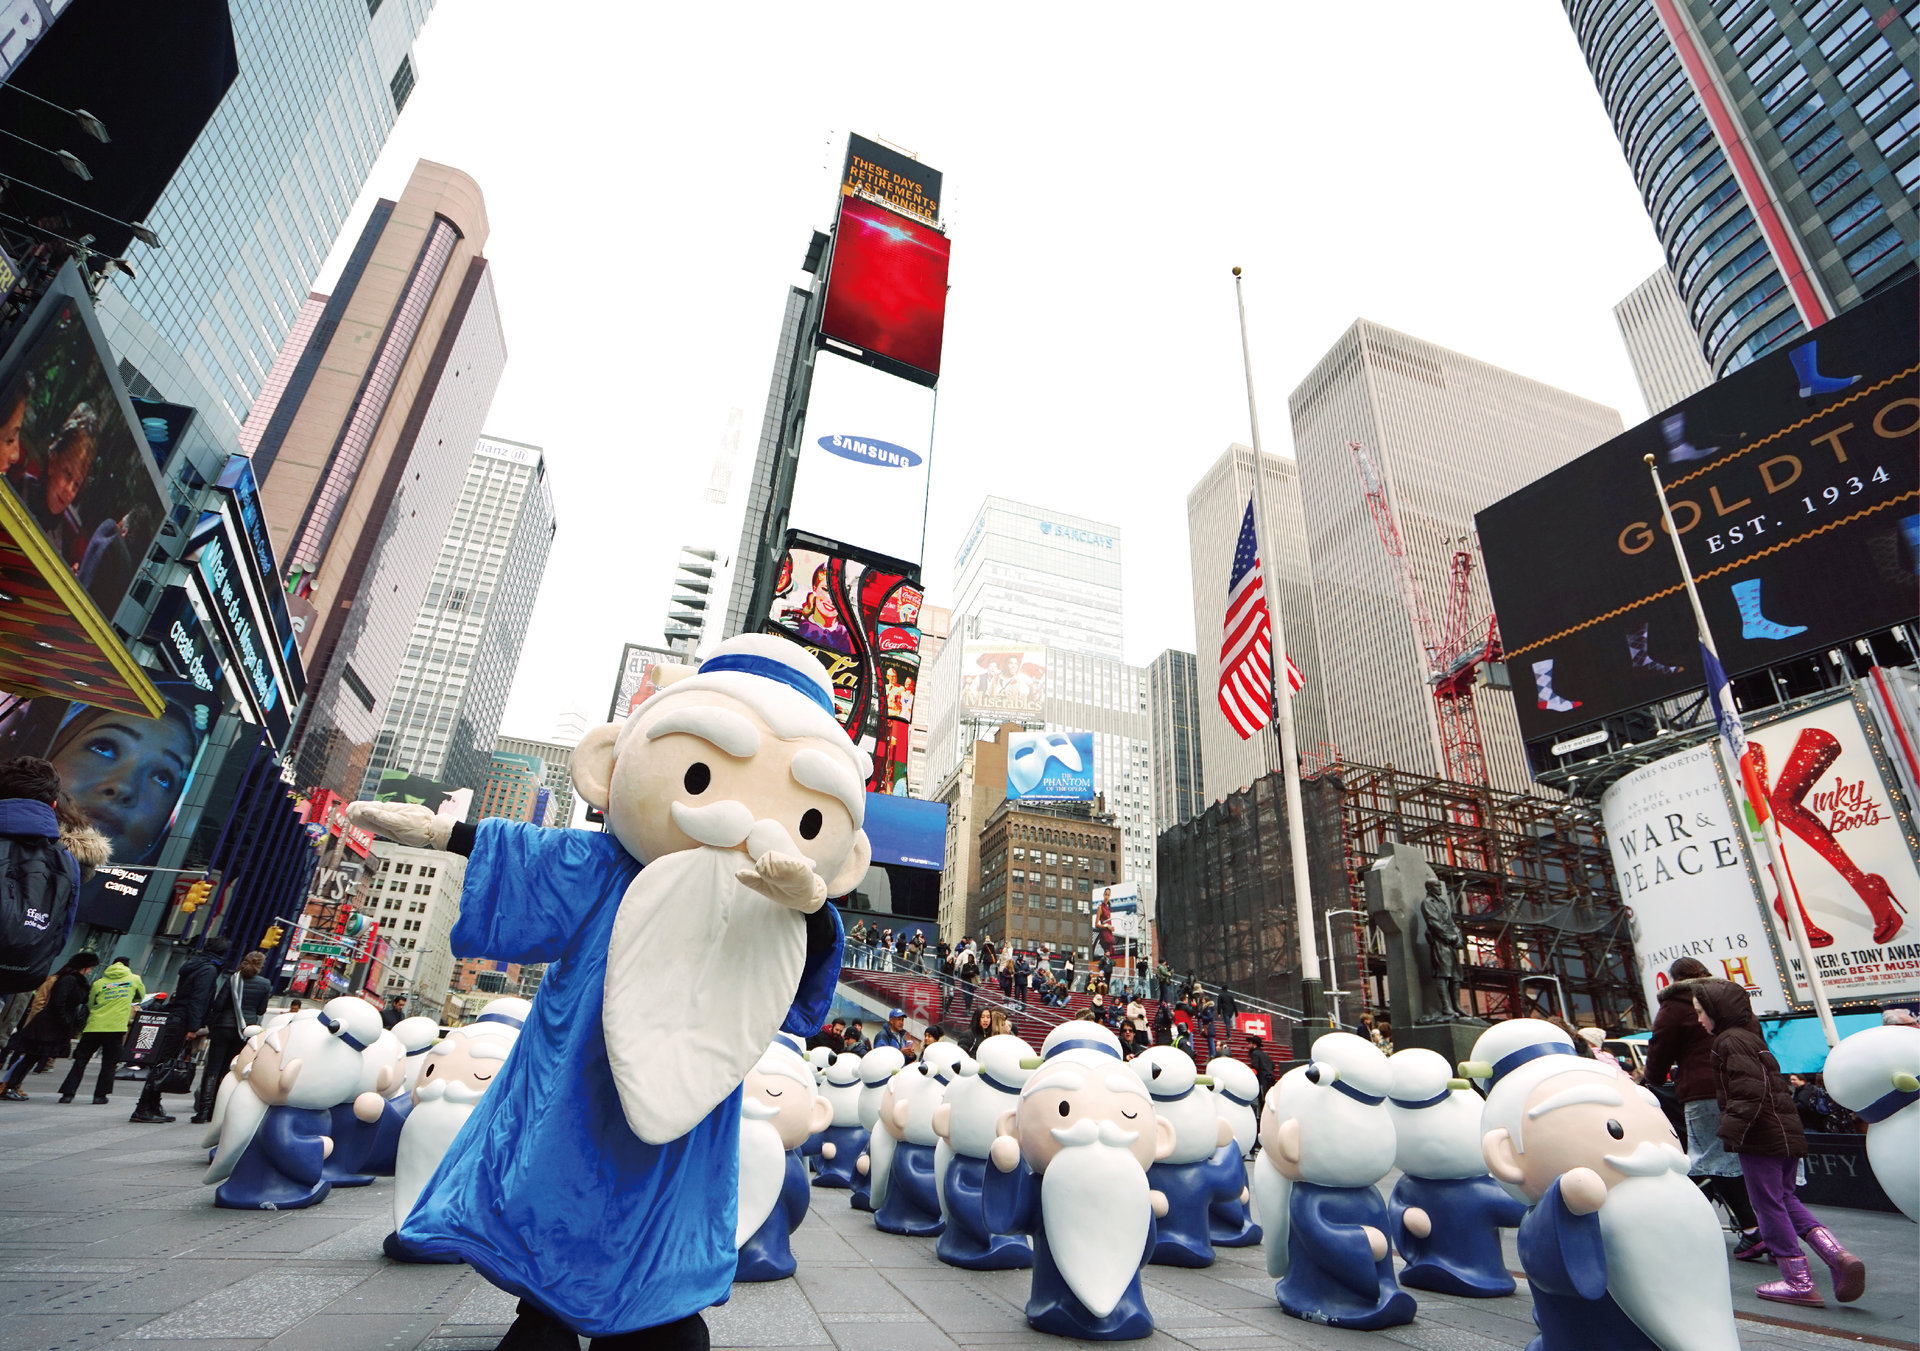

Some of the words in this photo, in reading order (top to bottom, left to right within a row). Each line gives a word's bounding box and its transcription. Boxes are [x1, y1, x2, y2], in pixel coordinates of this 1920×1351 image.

[850, 165, 937, 210] RETIREMENTS
[853, 155, 890, 179] THESE
[893, 173, 922, 194] DAYS
[848, 175, 881, 195] LAST
[885, 191, 932, 219] LONGER
[832, 433, 910, 469] SAMSUNG
[1705, 514, 1784, 554] EST.
[1802, 465, 1891, 515] 1934
[1055, 526, 1113, 549] BARCLAYS
[207, 535, 228, 588] What
[221, 579, 233, 607] we
[228, 598, 241, 623] do
[1660, 750, 1709, 772] NORTON
[1043, 778, 1091, 787] PHANTOM
[1619, 813, 1693, 860] WAR
[1695, 812, 1717, 828] &
[1829, 803, 1892, 834] Boots
[1622, 837, 1738, 898] PEACE
[104, 881, 139, 896] campus
[1648, 938, 1714, 969] JANUARY
[1725, 933, 1748, 951] 18
[1841, 952, 1851, 966] 6
[1851, 948, 1884, 965] TONY
[1848, 964, 1881, 975] BEST
